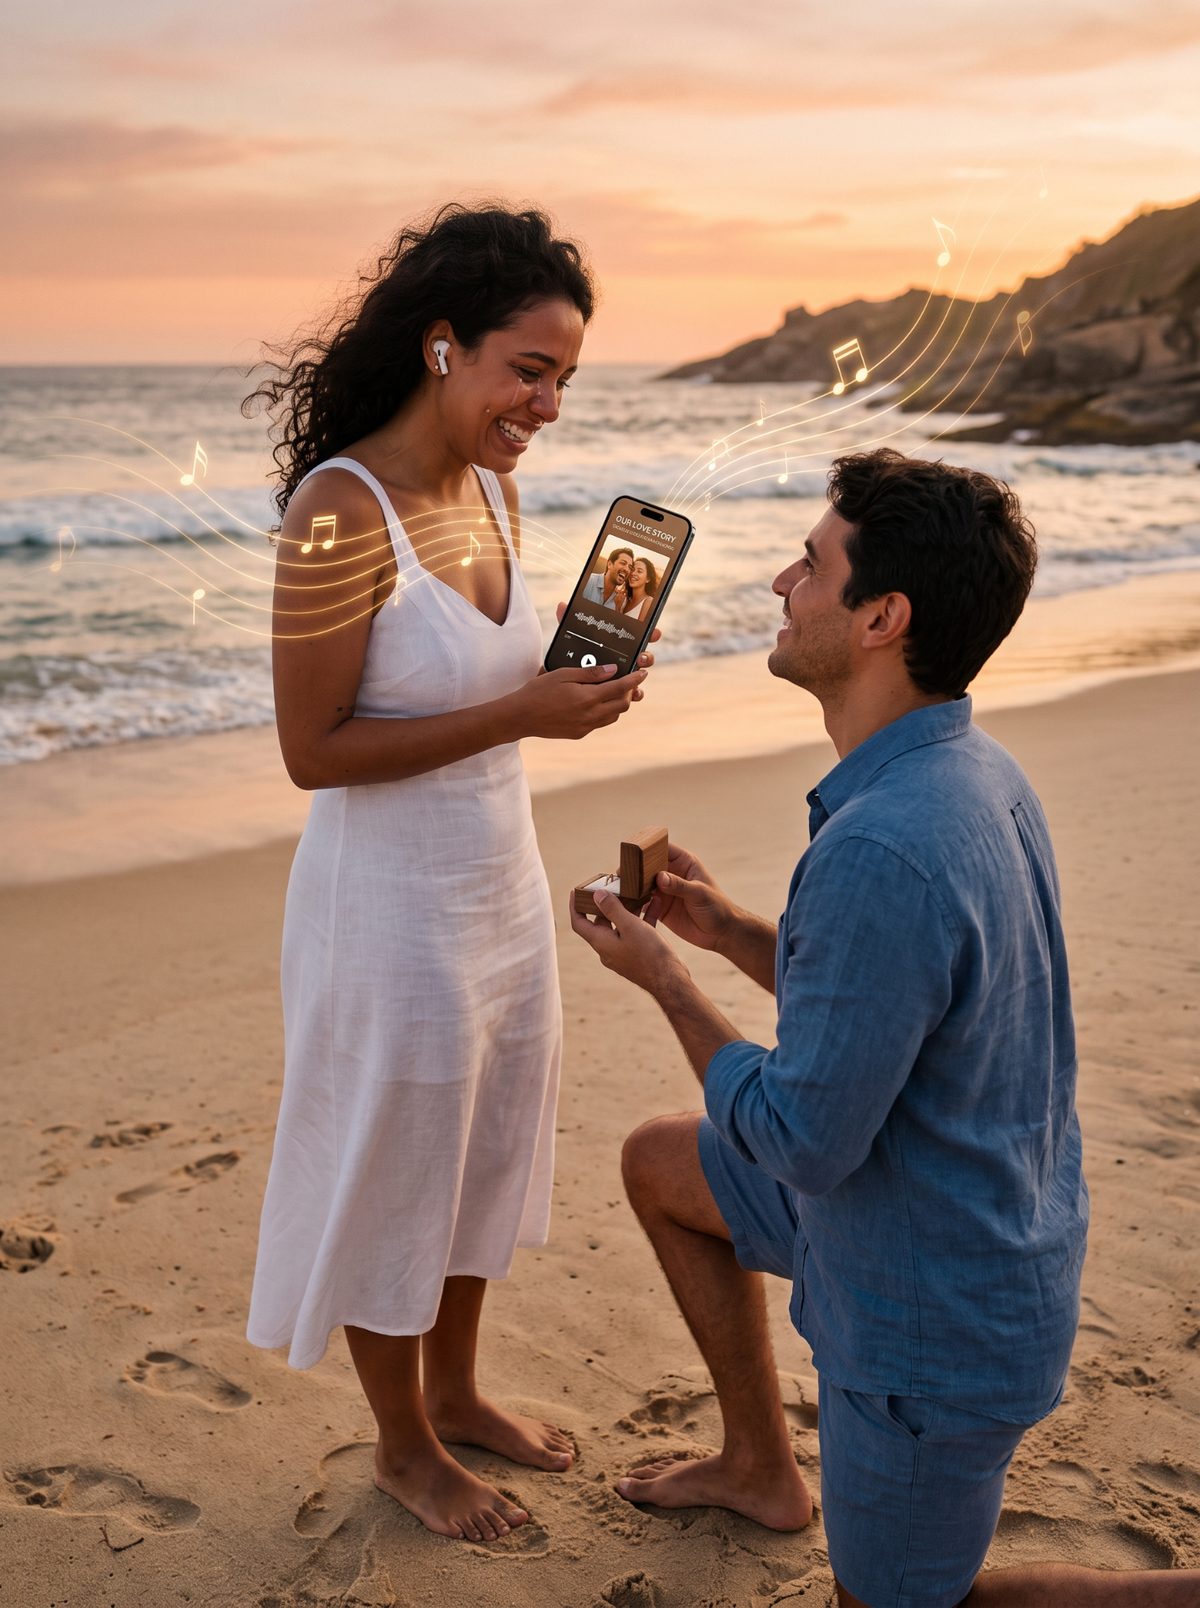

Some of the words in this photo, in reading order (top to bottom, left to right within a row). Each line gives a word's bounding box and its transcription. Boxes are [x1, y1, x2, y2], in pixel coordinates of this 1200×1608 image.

[616, 515, 631, 526] OUR
[632, 521, 652, 534] LOVE
[652, 528, 676, 543] STORY
